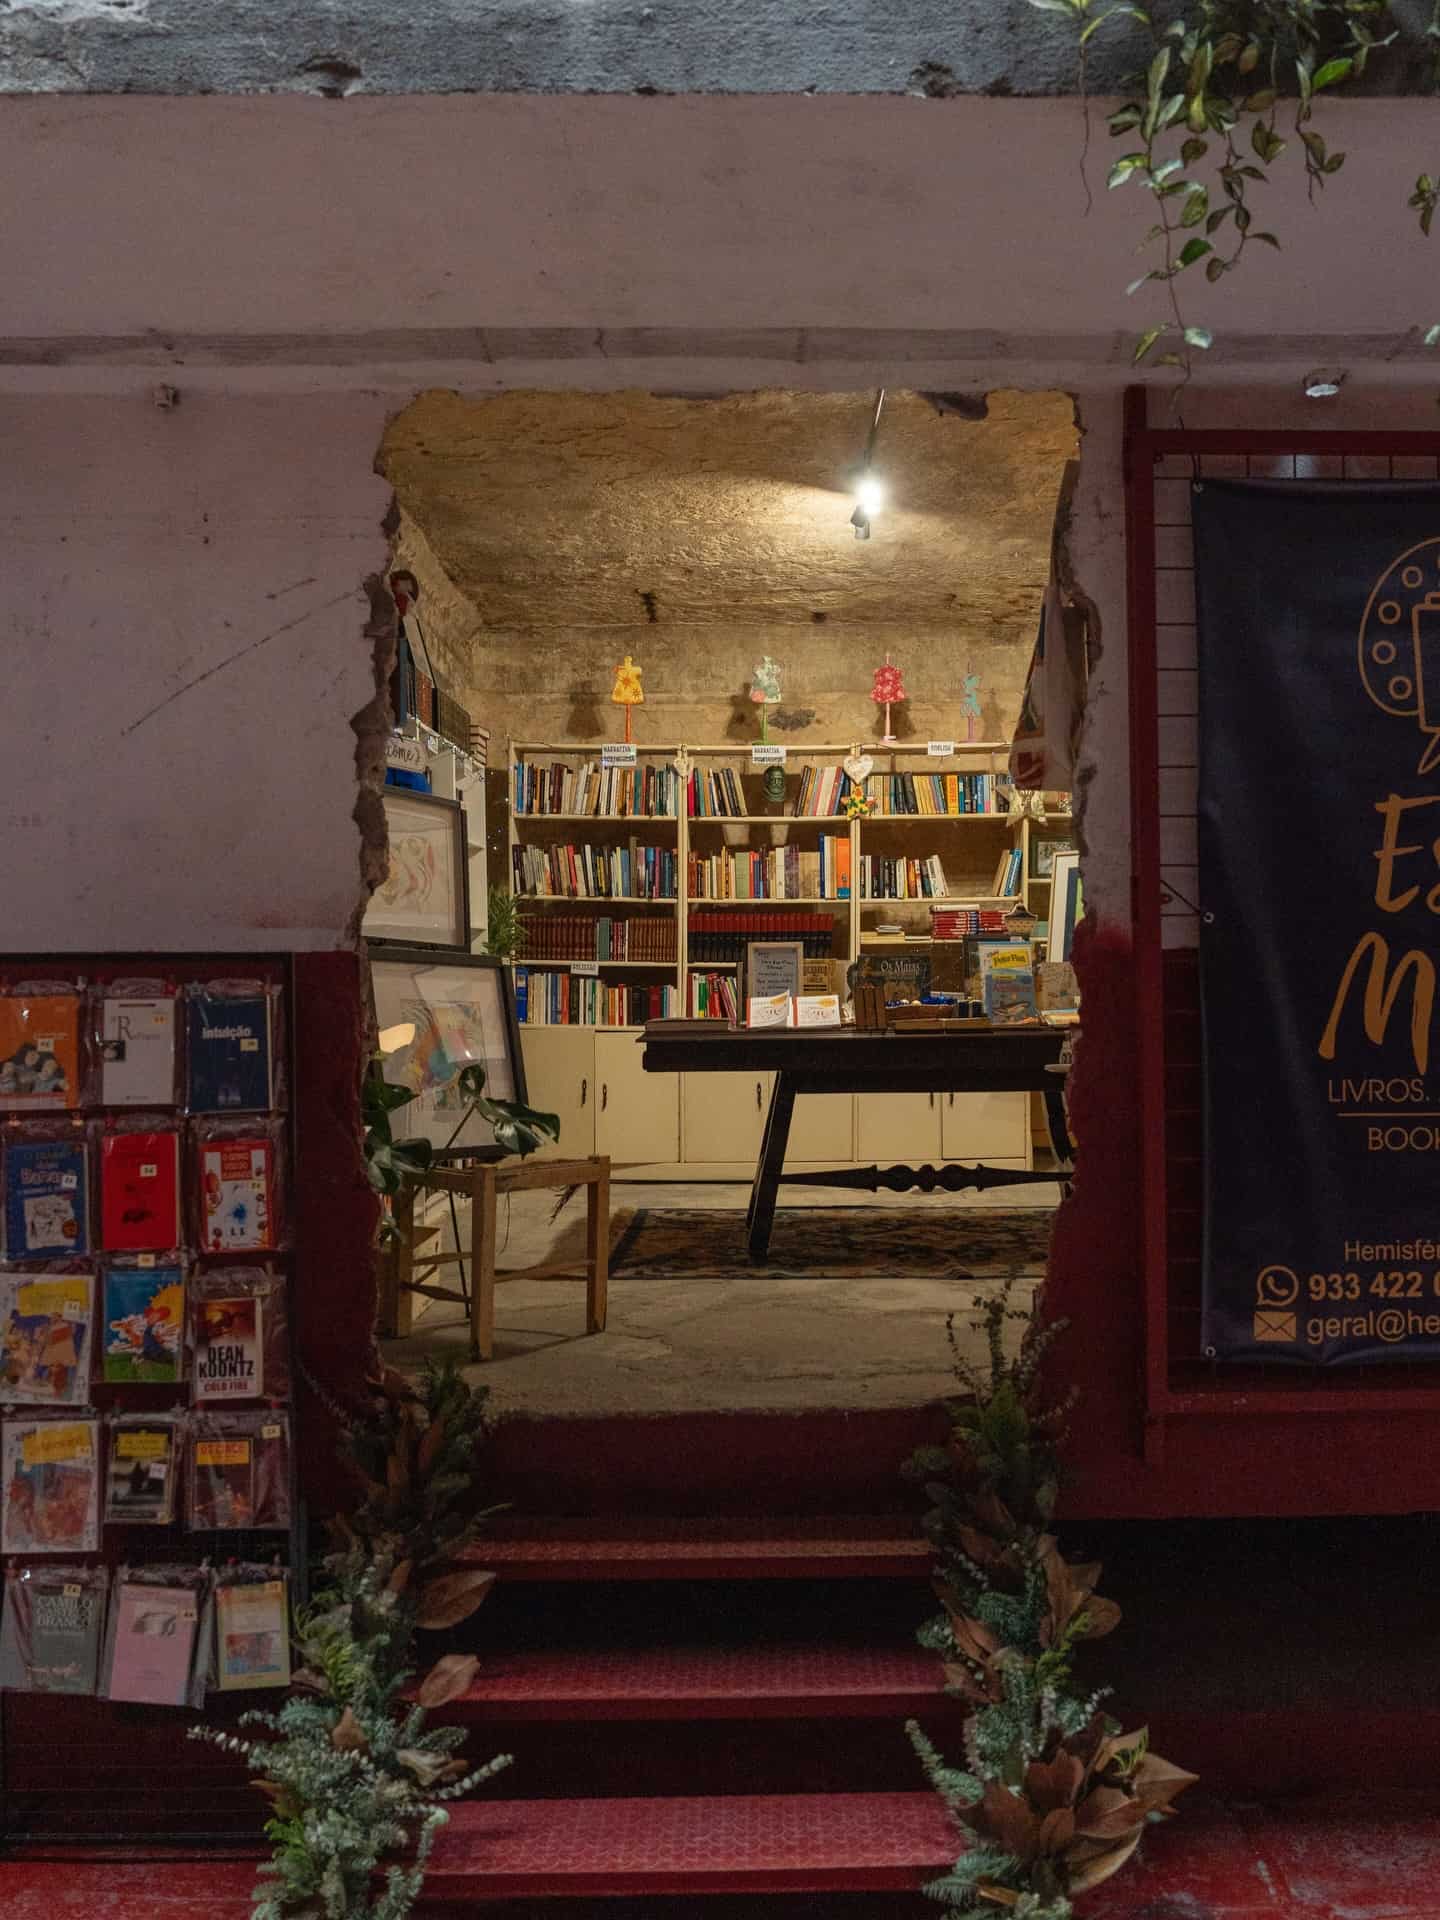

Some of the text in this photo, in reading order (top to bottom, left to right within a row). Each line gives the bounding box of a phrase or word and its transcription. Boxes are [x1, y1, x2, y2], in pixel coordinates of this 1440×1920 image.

[202, 1024, 252, 1040] Intuição
[1308, 1271, 1361, 1301] 933
[1369, 1270, 1424, 1298] 422
[208, 1345, 244, 1361] DEAN
[198, 1360, 254, 1378] KOONTZ
